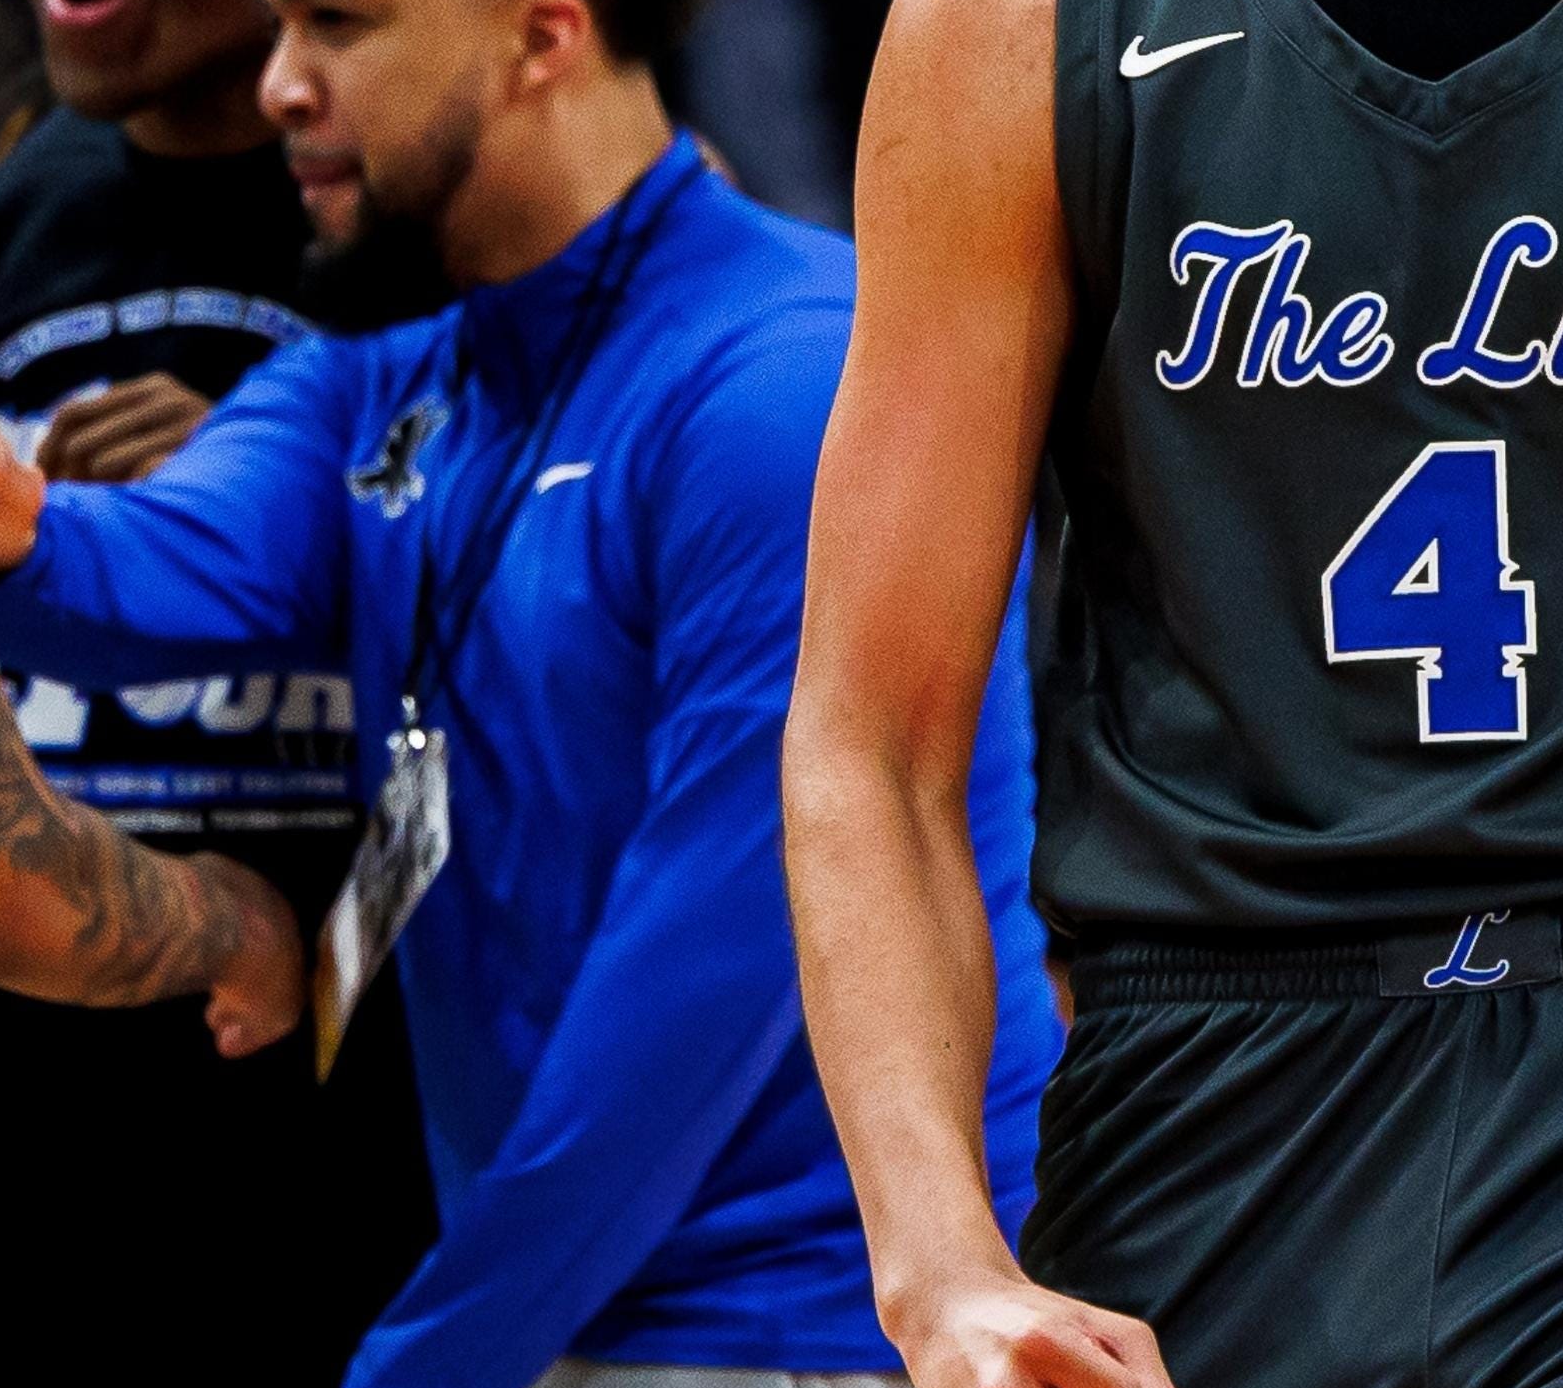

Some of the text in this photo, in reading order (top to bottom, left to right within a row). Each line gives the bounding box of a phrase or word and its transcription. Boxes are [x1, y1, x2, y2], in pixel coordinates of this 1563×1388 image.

[1154, 218, 1395, 390] The
[1320, 440, 1537, 744] 4
[1424, 909, 1511, 988] L
